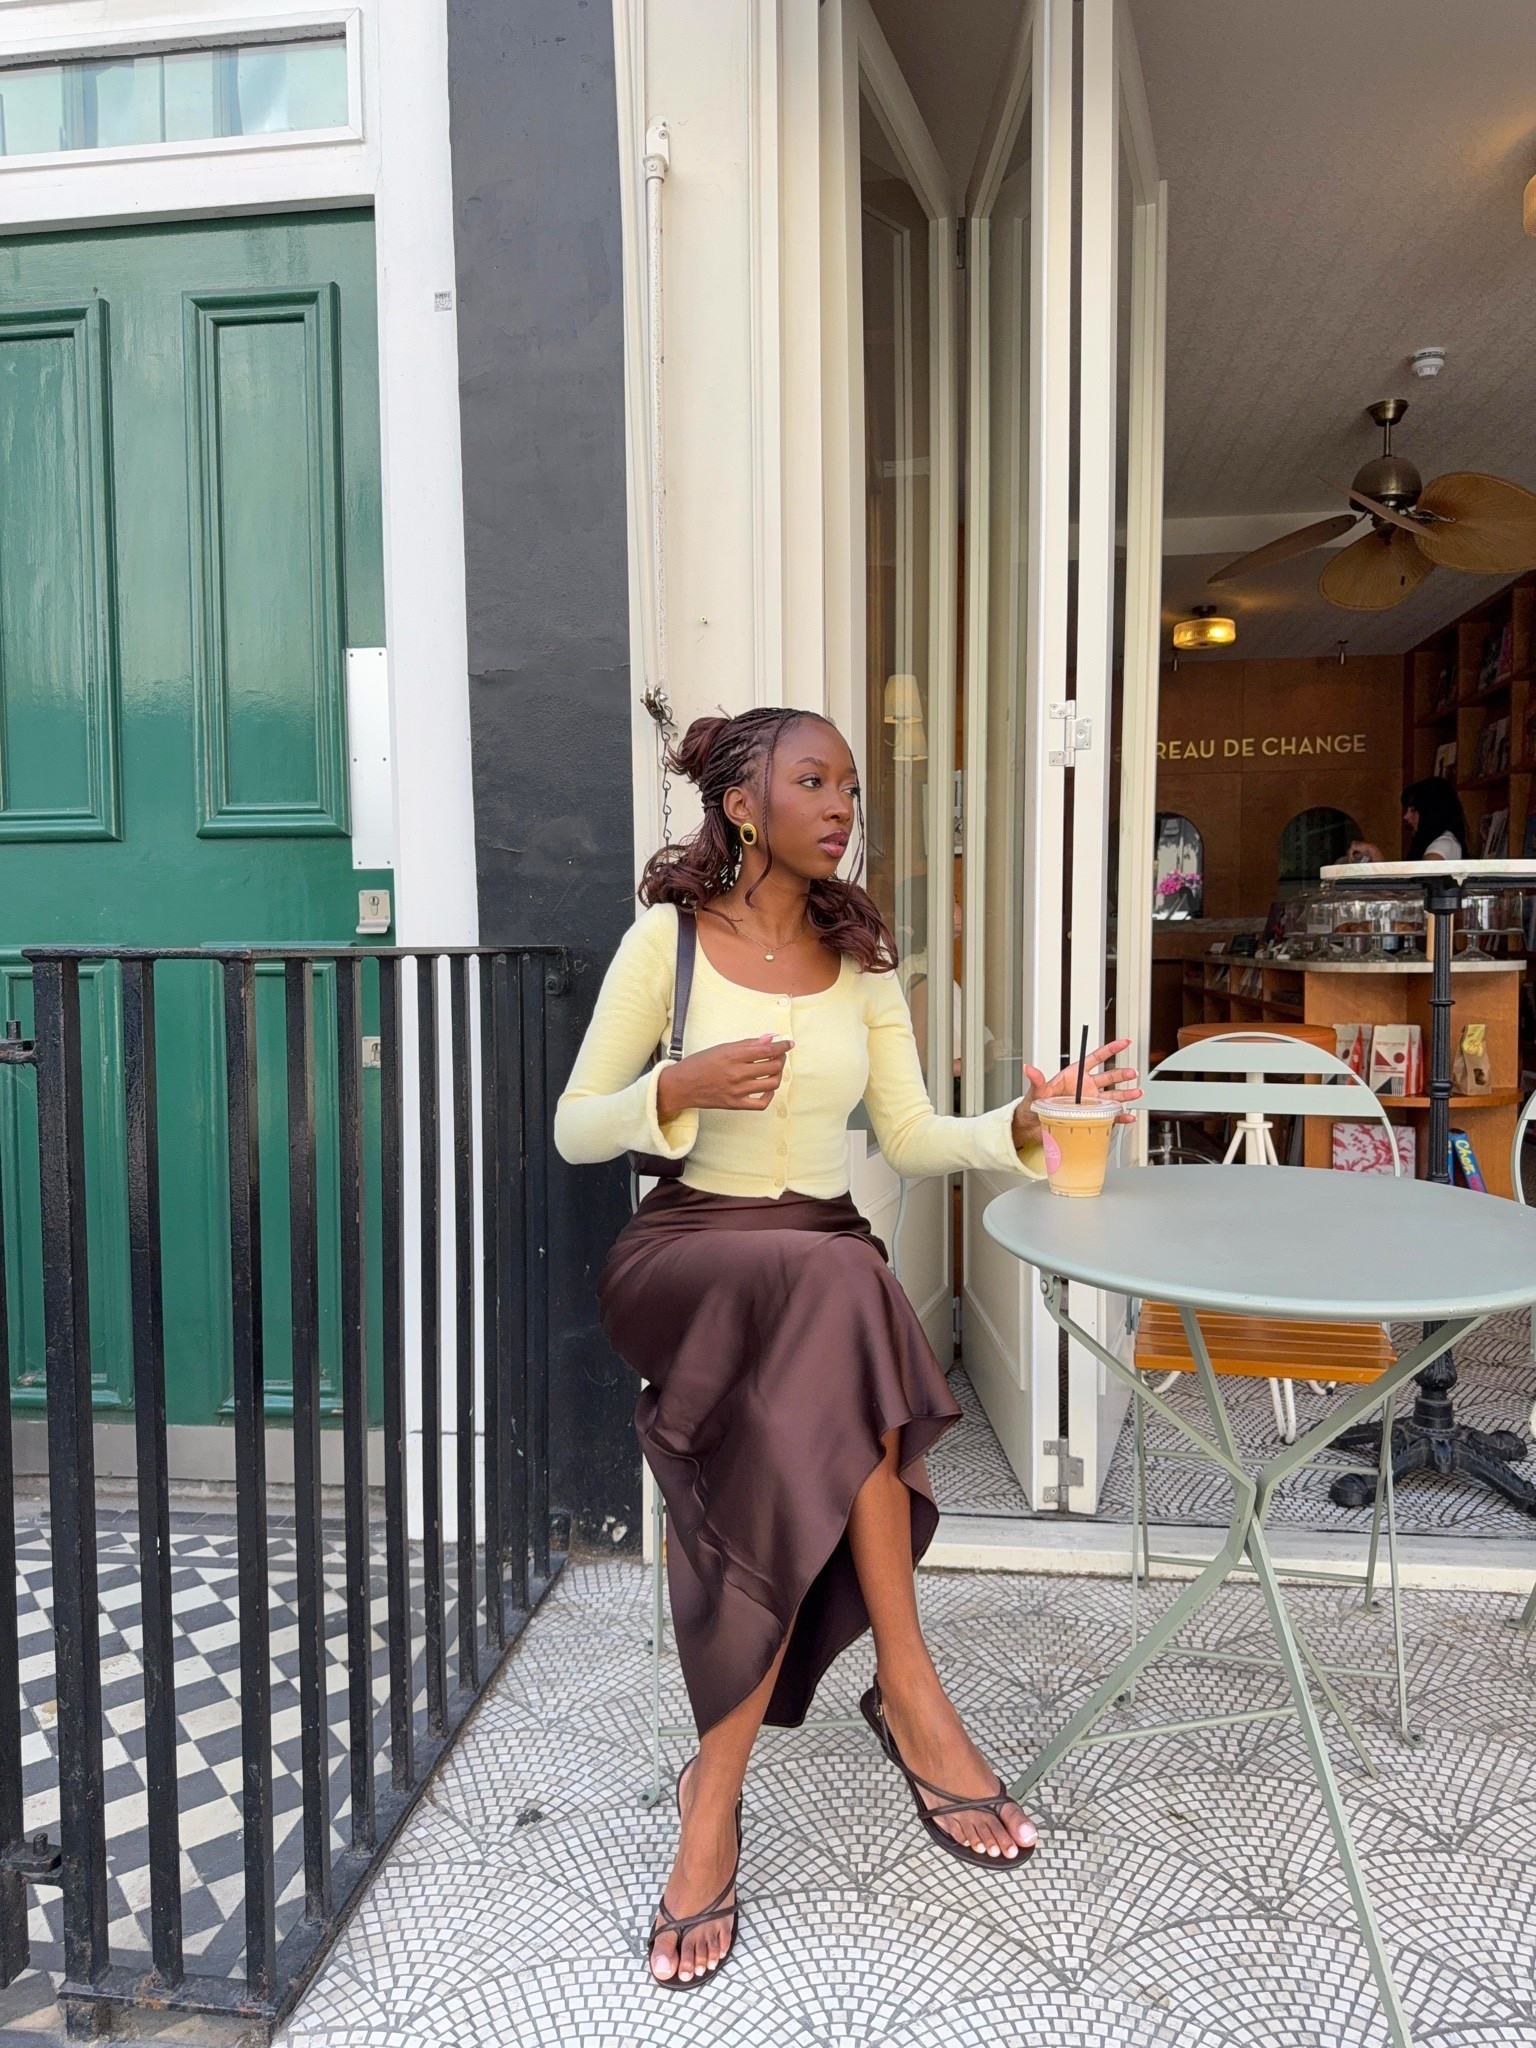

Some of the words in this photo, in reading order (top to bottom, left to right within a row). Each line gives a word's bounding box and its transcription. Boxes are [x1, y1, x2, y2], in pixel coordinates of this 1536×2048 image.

[1156, 739, 1215, 760] REAU
[1223, 738, 1255, 757] DE
[1261, 734, 1366, 756] CHANGE
